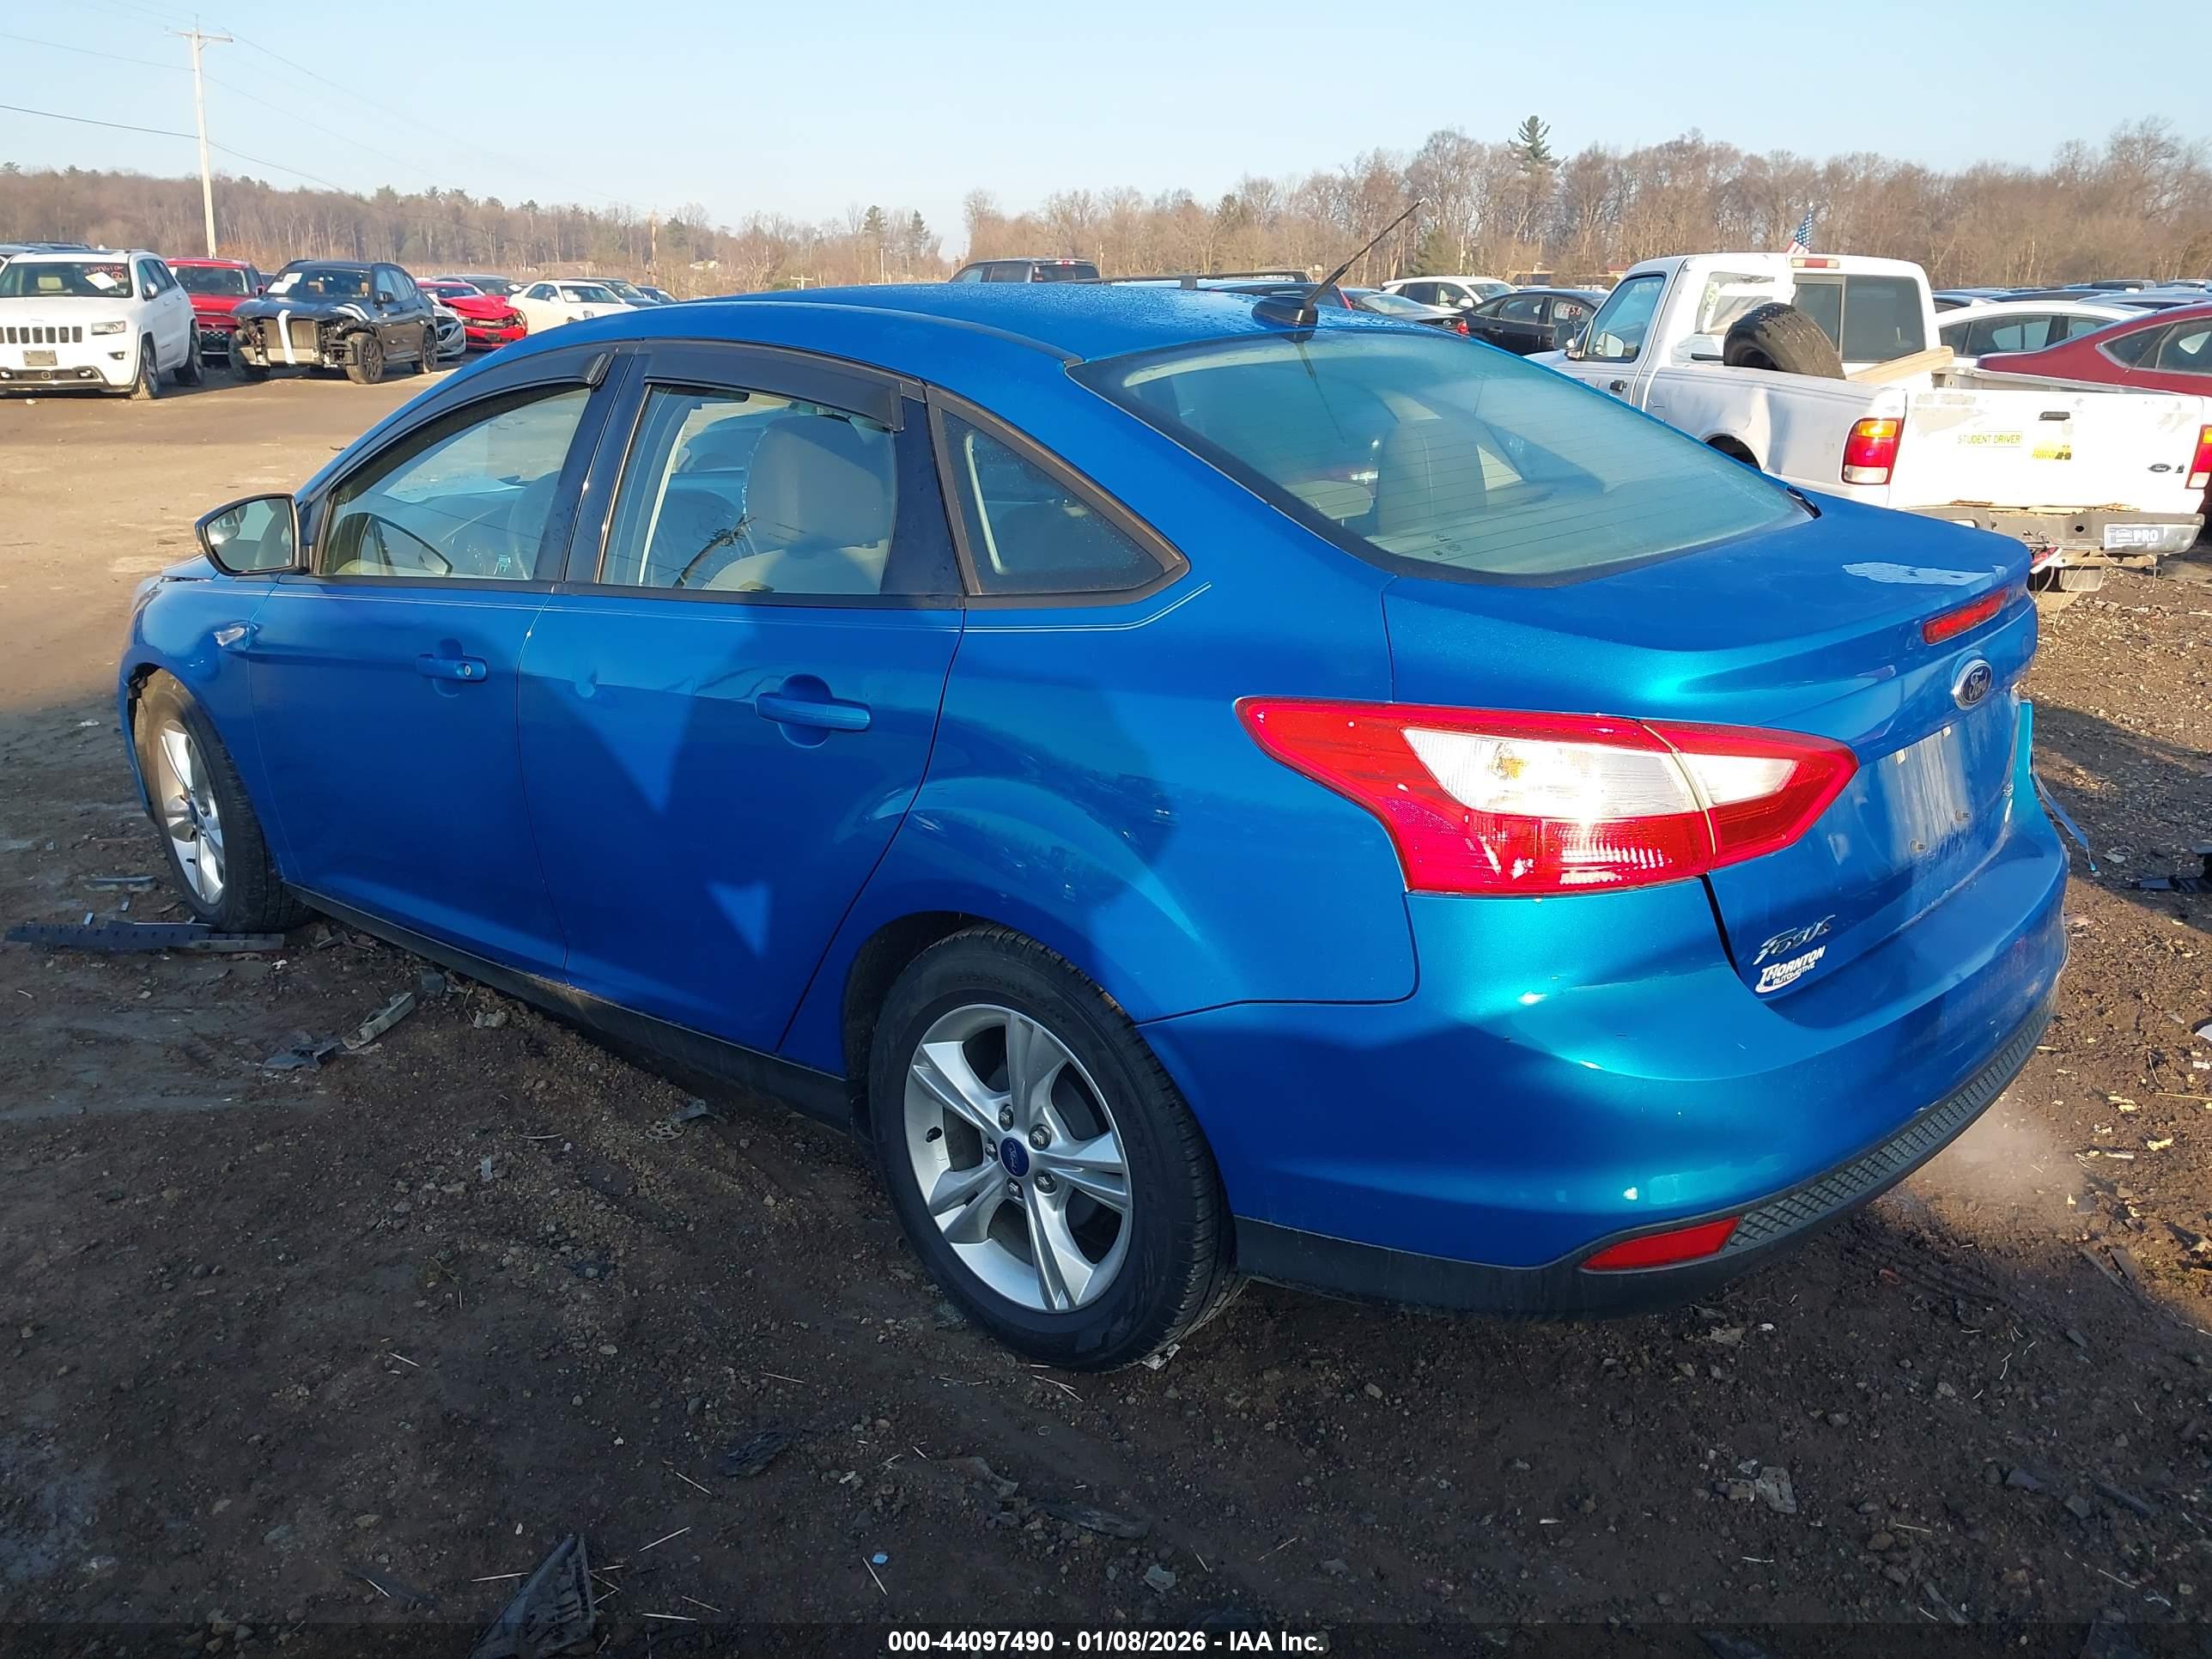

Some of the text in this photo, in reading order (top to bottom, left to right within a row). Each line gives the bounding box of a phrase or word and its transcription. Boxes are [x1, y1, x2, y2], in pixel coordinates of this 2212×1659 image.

[1957, 434, 2021, 444] STUDENT DRIVER
[2132, 529, 2159, 543] PRO
[1967, 668, 1989, 702] Ford
[1753, 914, 1836, 965] Focus
[1758, 945, 1826, 989] THORNTON
[1772, 961, 1815, 986] AUTOMOTIVE
